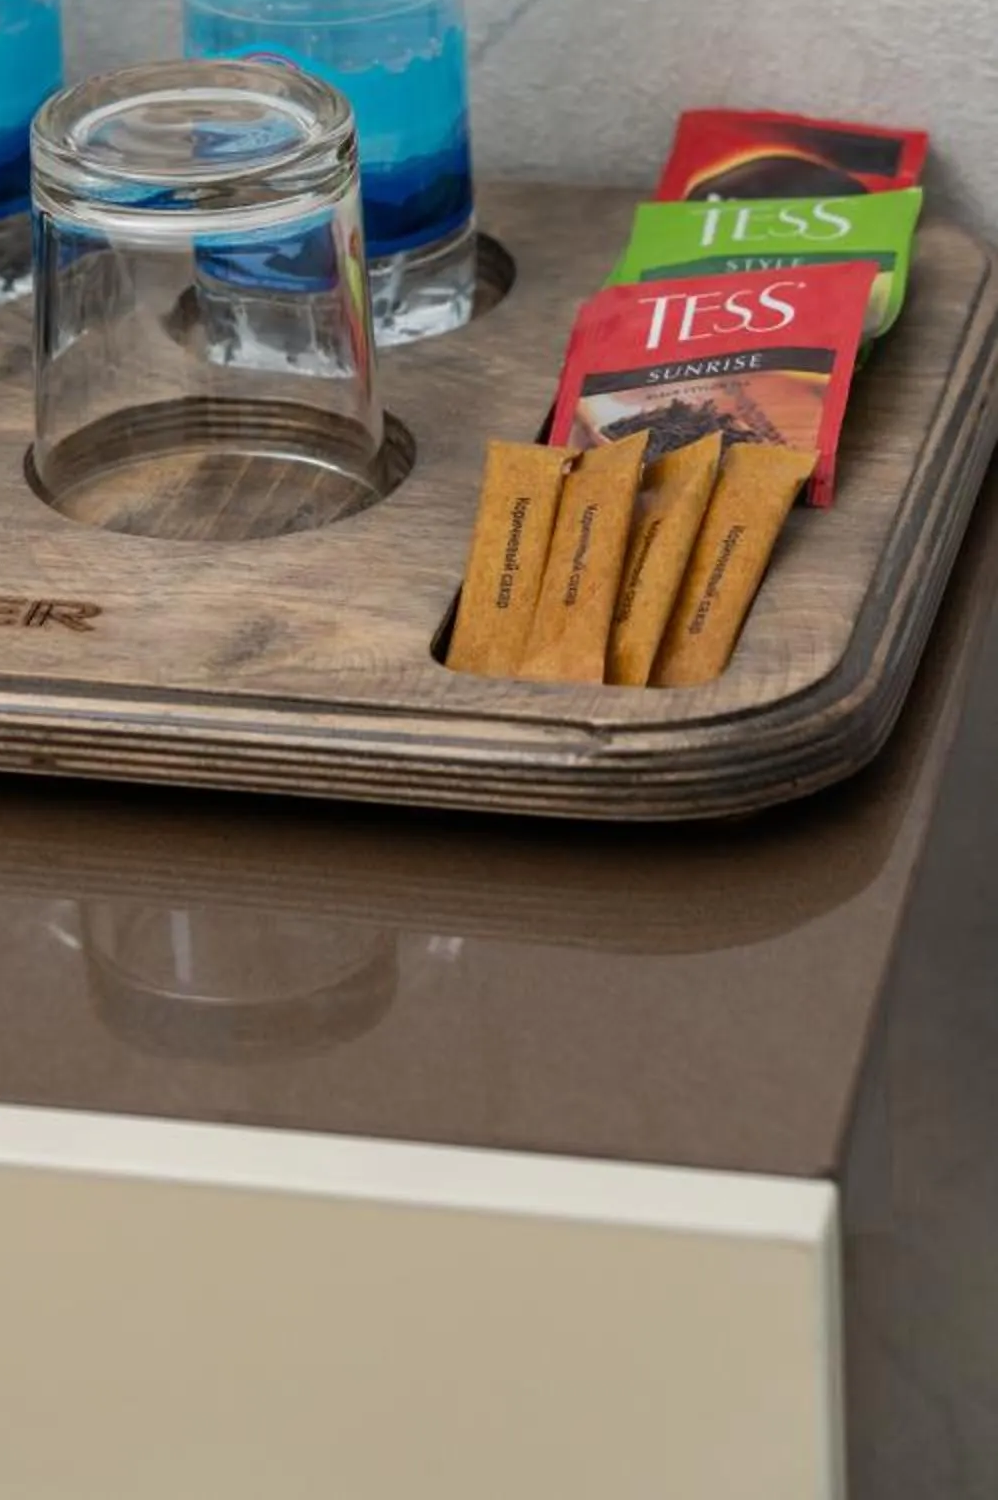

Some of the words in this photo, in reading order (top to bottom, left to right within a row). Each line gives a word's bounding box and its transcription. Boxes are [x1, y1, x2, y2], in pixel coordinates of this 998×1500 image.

[692, 198, 858, 246] TESS
[638, 281, 796, 349] TESS
[646, 353, 762, 383] SUNRISE
[496, 573, 513, 609] сахар
